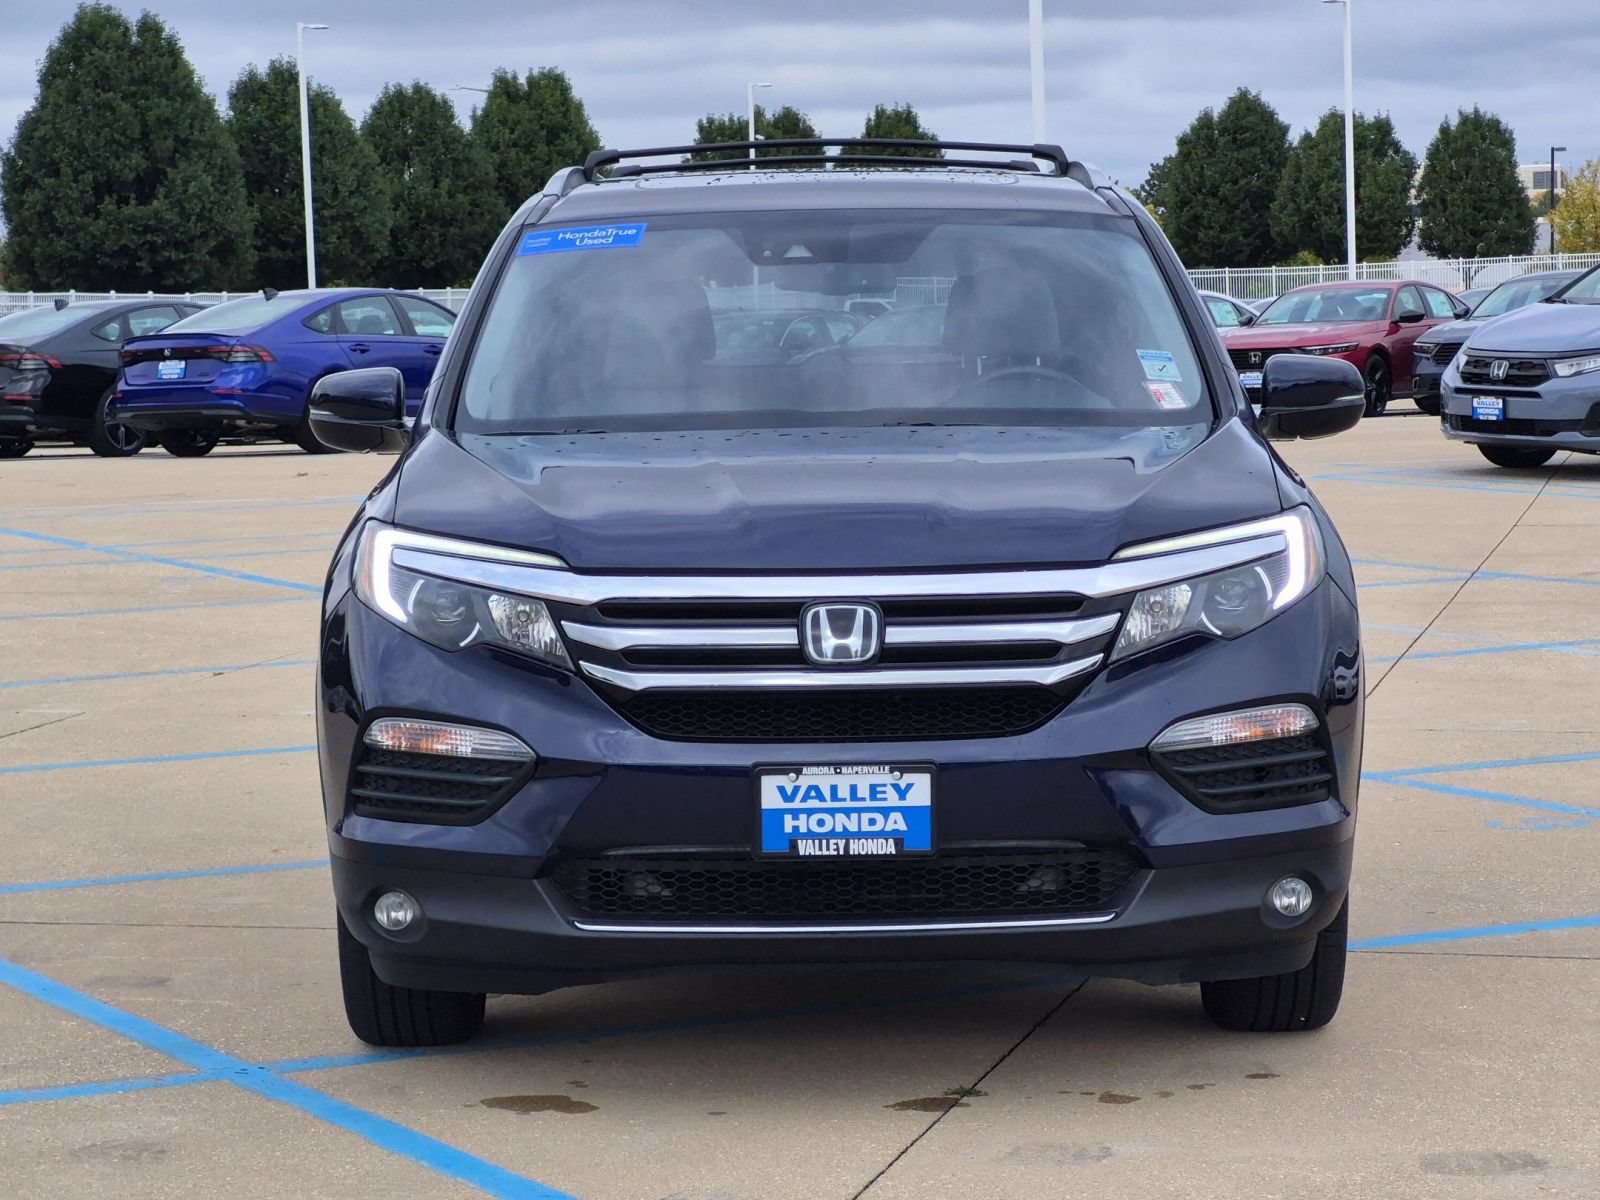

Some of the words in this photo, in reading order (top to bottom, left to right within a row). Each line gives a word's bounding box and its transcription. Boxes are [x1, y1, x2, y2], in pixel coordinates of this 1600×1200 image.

[558, 228, 637, 240] HondaTrue
[575, 237, 613, 246] Used
[802, 767, 835, 775] AURORA
[841, 766, 890, 775] NAPERVILLE
[776, 783, 915, 803] VALLEY
[784, 812, 908, 833] HONDA
[797, 839, 846, 856] VALLEY
[849, 838, 896, 855] HONDA
